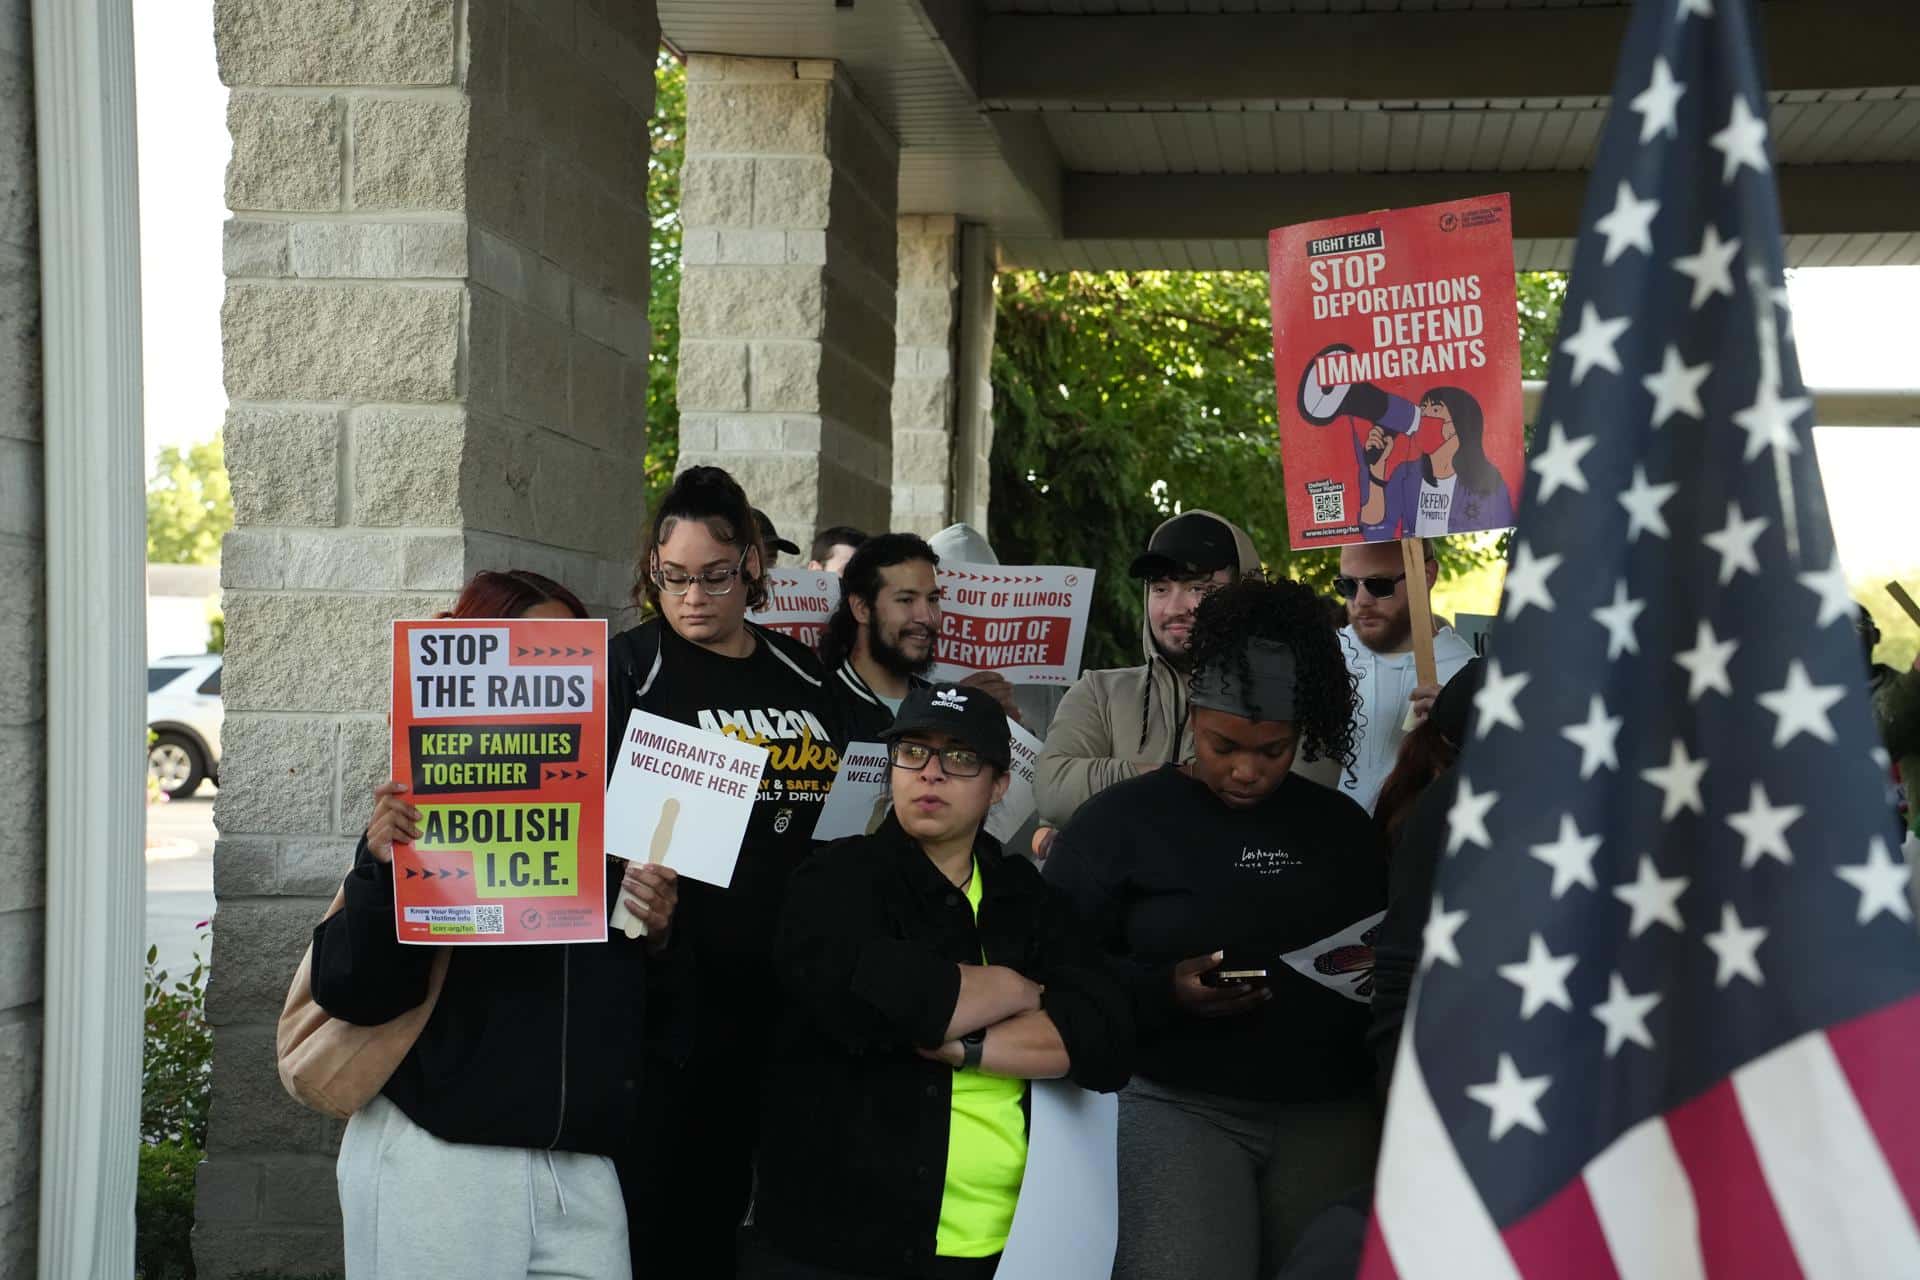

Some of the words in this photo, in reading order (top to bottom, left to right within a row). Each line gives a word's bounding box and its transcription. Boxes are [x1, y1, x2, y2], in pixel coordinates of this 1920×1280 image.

[1312, 237, 1344, 254] FIGHT
[1348, 232, 1376, 248] FEAR
[1310, 253, 1386, 292] STOP
[1313, 275, 1481, 320] DEPORTATIONS
[1373, 304, 1484, 348] DEFEND
[1317, 339, 1487, 386] IMMIGRANTS
[1420, 491, 1450, 510] DEFEND
[775, 596, 829, 613] ILLINOIS
[957, 588, 987, 607] OUT
[991, 592, 1010, 608] OF
[1013, 591, 1072, 608] ILLINOIS
[984, 621, 1023, 643] OUT
[1026, 620, 1052, 641] OF
[420, 634, 499, 666] STOP
[932, 638, 1049, 666] VERYWHERE
[416, 675, 476, 708] THE
[487, 674, 586, 708] RAIDS
[931, 699, 964, 712] adidas
[697, 708, 831, 742] AMAZON
[421, 733, 473, 756] KEEP
[480, 733, 572, 755] FAMILIES
[630, 727, 726, 769] IMMIGRANTS
[729, 758, 761, 780] ARE
[422, 763, 527, 785] TOGETHER
[846, 754, 888, 768] IMMIG
[631, 751, 704, 787] WELCOME
[707, 776, 748, 800] HERE
[786, 780, 819, 791] SAFE
[789, 792, 828, 802] DRIV
[424, 808, 569, 844] ABOLISH
[486, 851, 569, 887] I.C.E.
